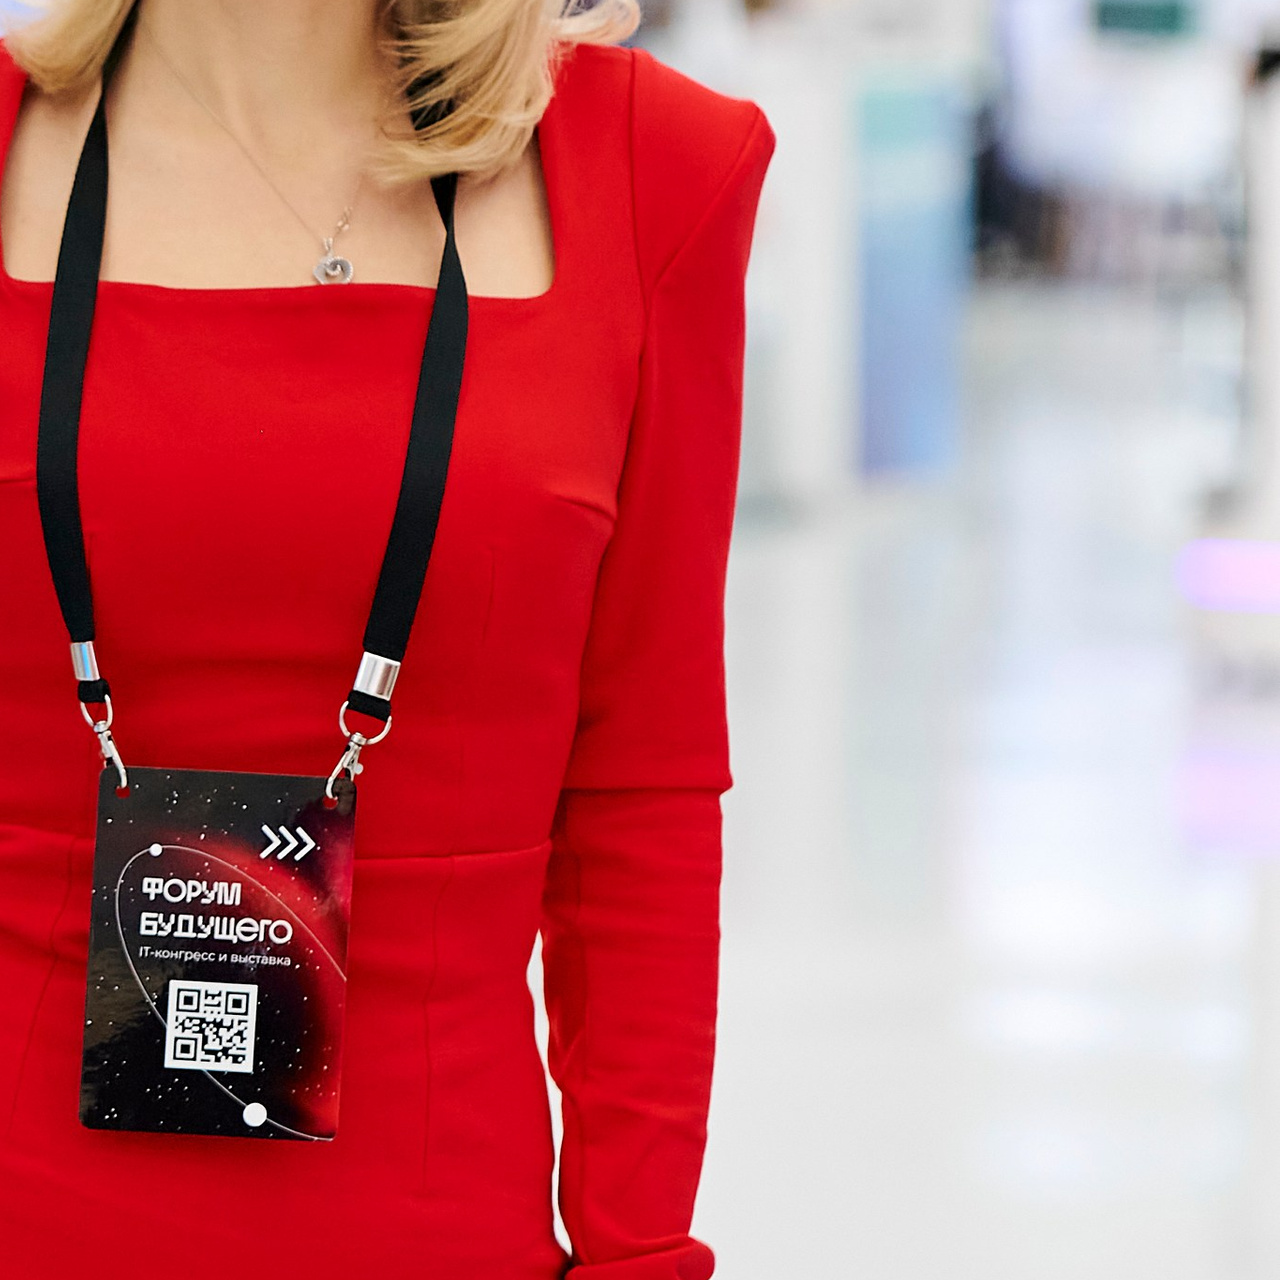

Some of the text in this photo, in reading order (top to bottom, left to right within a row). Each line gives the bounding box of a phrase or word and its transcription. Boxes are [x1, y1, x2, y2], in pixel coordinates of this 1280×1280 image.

[142, 877, 242, 905] ФОРУМ
[139, 946, 291, 966] IT-конгресс и выставка
